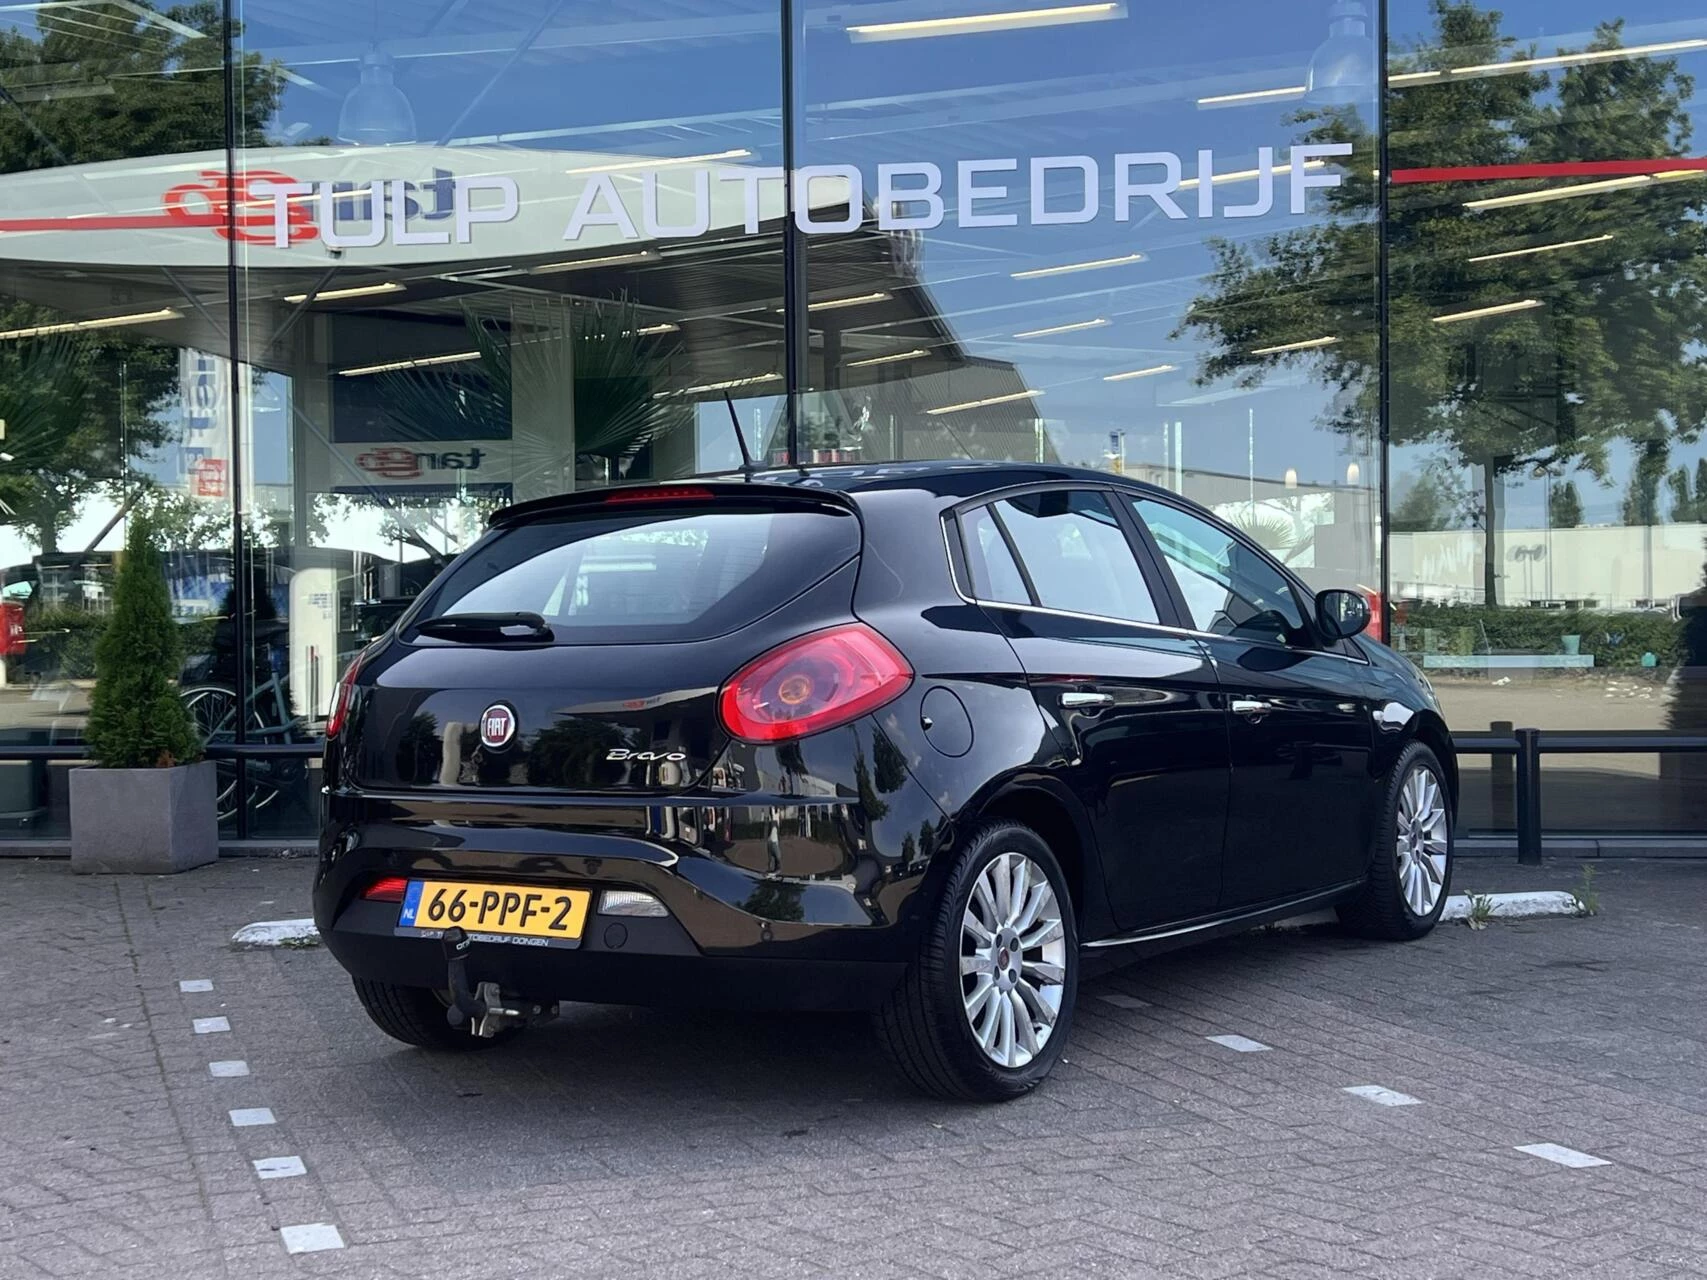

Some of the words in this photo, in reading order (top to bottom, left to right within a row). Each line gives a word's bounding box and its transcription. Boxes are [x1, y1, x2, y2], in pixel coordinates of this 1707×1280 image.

[249, 176, 520, 249] TULP
[562, 142, 1353, 241] AUTOBEDRIJF
[486, 716, 507, 737] FIAT
[606, 748, 687, 762] Bravo
[403, 907, 415, 919] NL
[427, 887, 572, 931] 66-PPF-2
[511, 935, 550, 947] DONGEN
